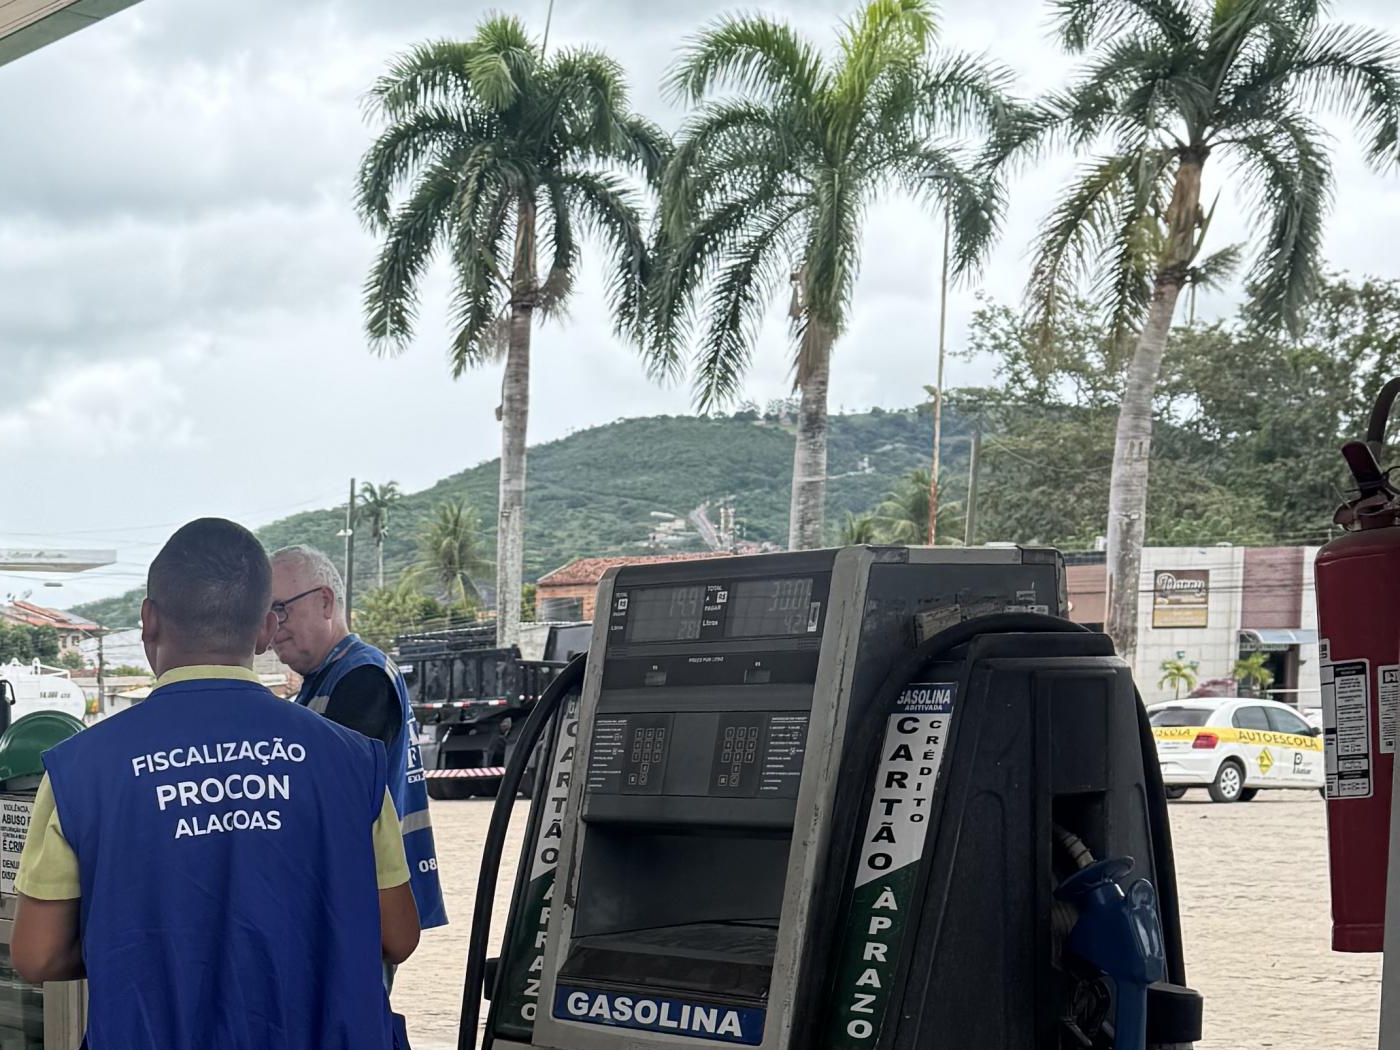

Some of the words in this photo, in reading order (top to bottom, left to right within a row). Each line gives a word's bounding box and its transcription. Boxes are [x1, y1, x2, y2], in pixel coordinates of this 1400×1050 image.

[131, 737, 306, 777] FISCALIZAÇÃO
[1238, 730, 1318, 749] AUTOESCOLA
[909, 720, 942, 823] CRÉDITO
[156, 774, 290, 811] PROCON
[867, 716, 920, 871] CARTÃO
[2, 813, 26, 826] ABUSO
[418, 858, 437, 873] 08
[567, 991, 743, 1037] GASOLINA
